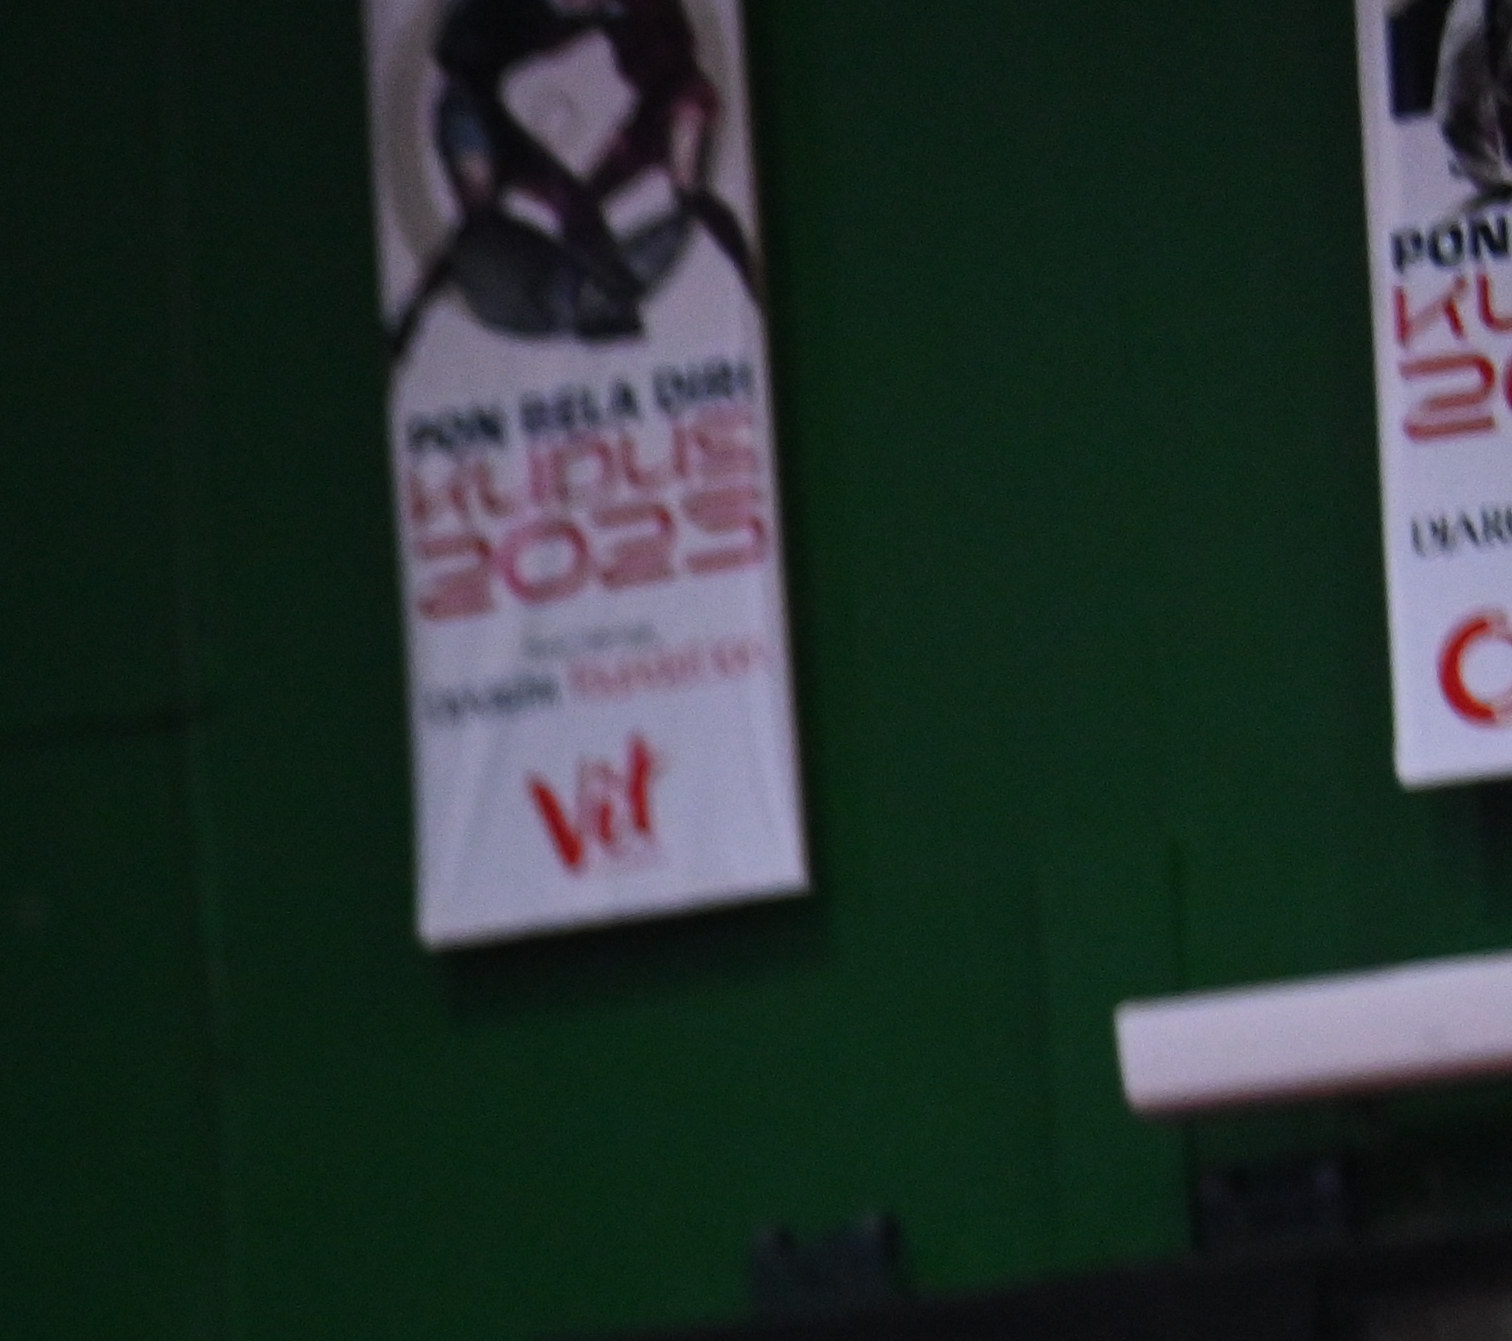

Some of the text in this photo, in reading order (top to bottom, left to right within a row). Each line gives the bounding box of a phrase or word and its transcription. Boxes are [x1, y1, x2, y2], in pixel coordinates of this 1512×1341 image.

[1391, 213, 1511, 273] PON
[1398, 352, 1512, 443] 2
[414, 484, 766, 621] 2025
